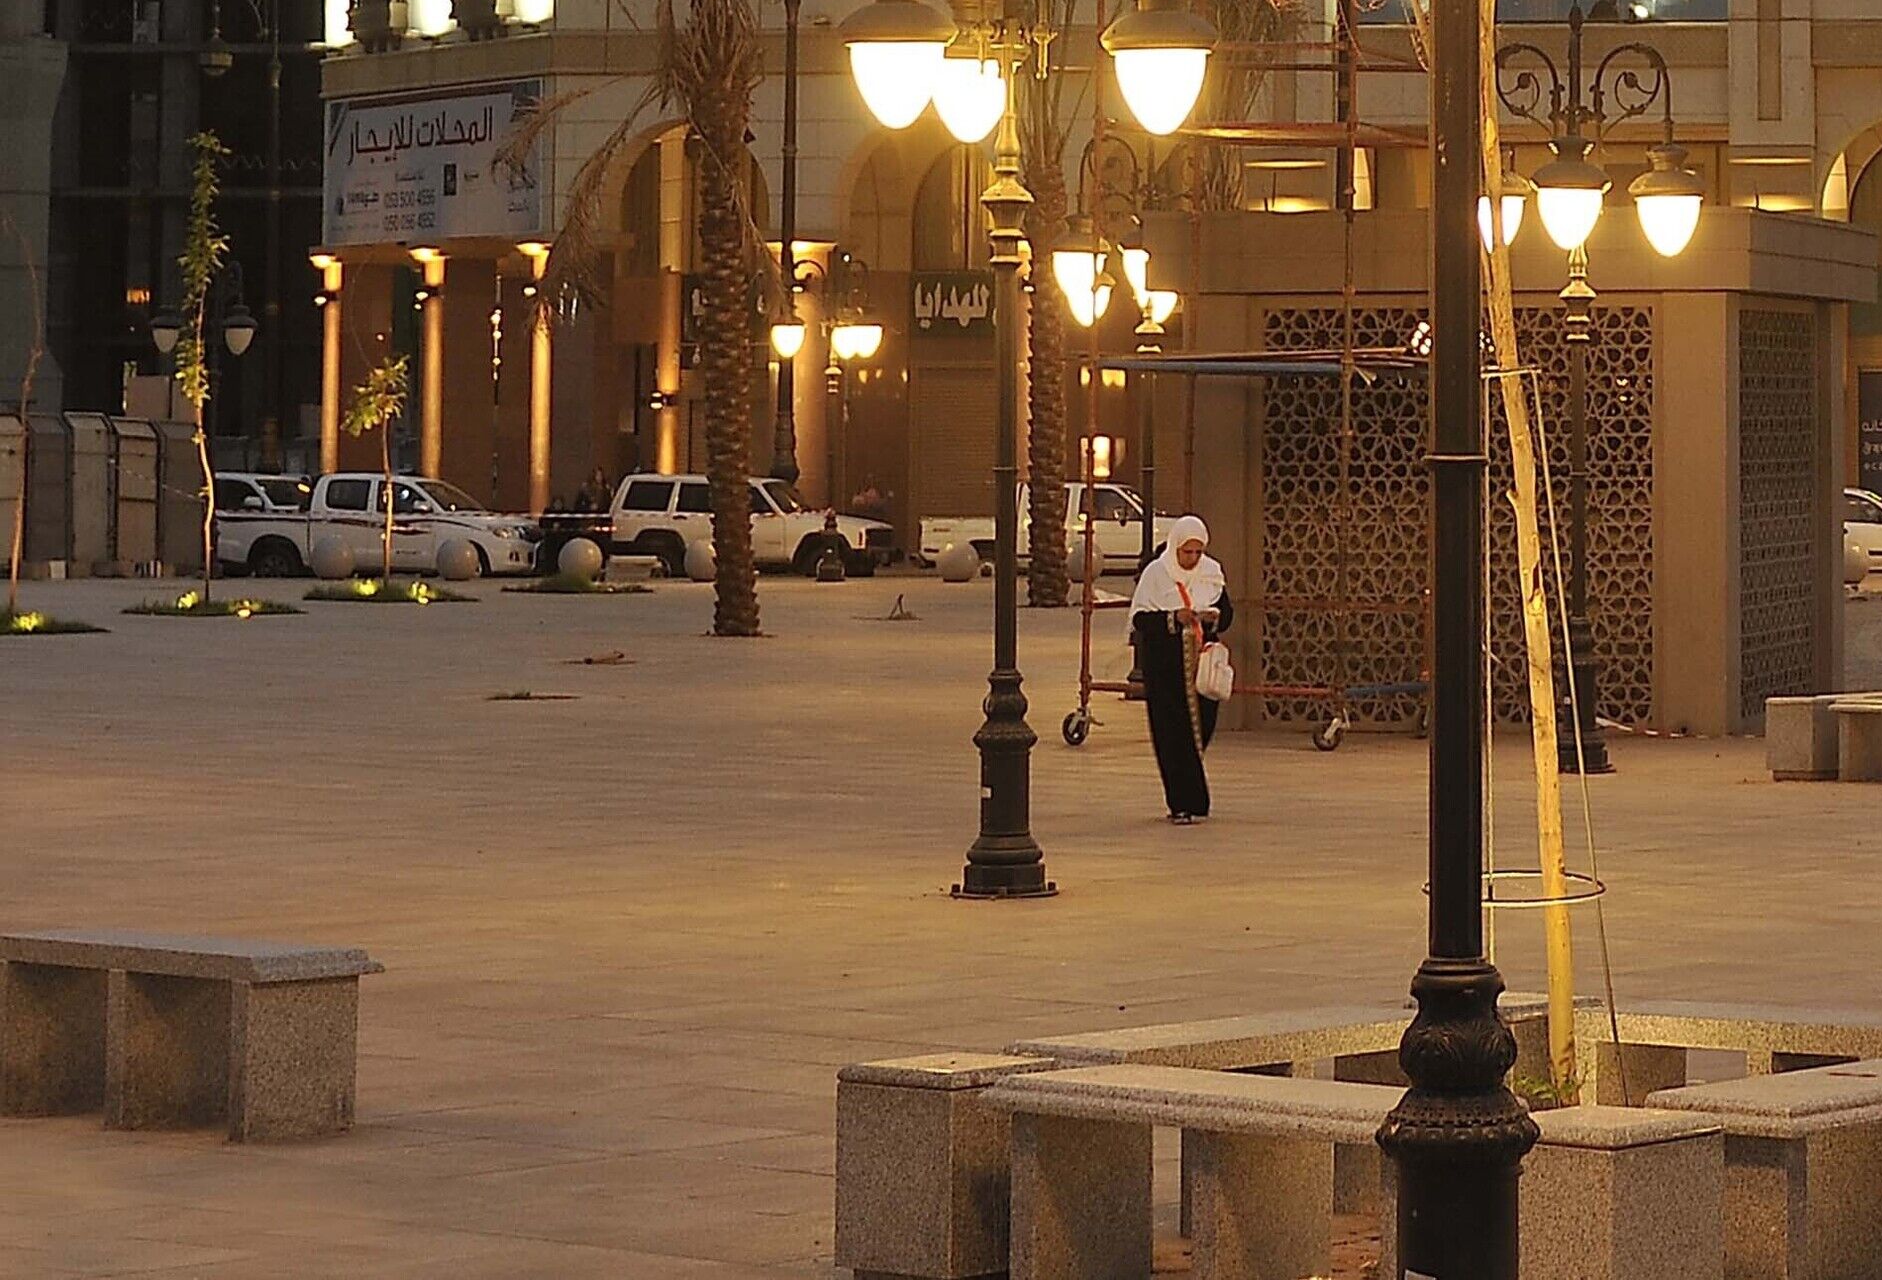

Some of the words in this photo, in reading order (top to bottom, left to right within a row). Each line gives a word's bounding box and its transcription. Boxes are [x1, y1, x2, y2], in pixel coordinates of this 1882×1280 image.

[347, 114, 414, 166] للإيجار
[416, 106, 494, 147] المحلات
[914, 281, 990, 329] للهدايا
